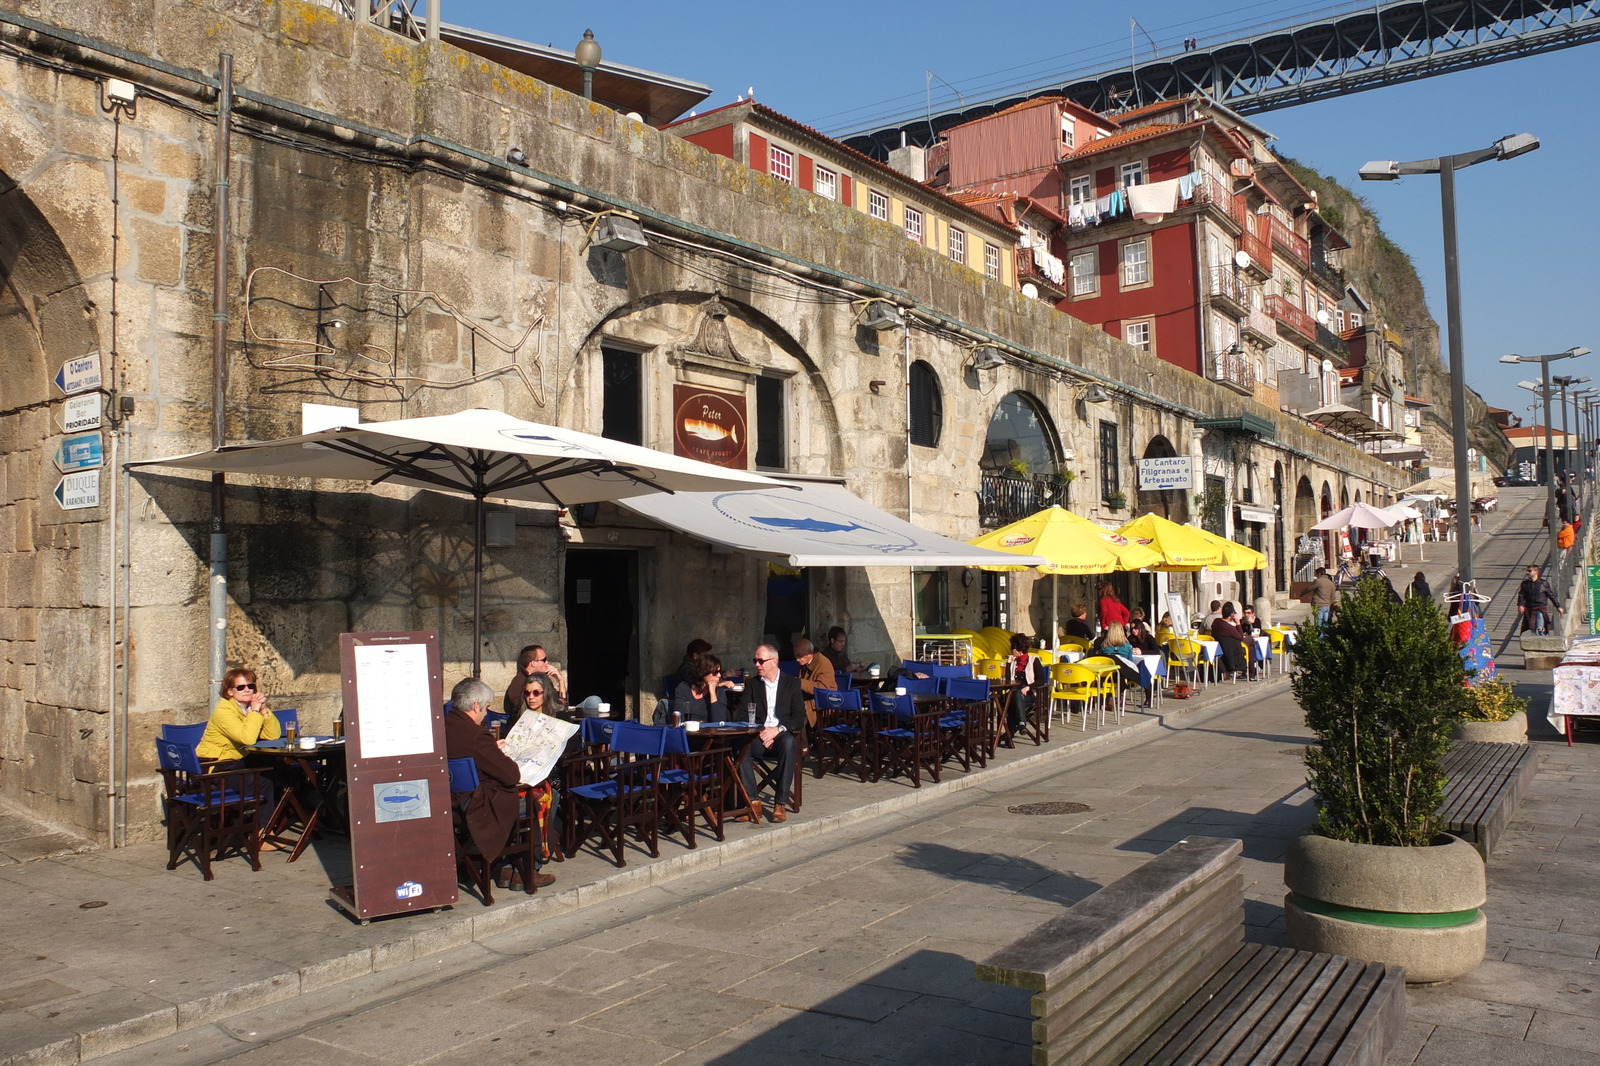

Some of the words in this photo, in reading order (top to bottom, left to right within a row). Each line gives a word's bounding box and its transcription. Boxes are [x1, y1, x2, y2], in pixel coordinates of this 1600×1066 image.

[76, 410, 87, 418] Bar
[702, 404, 721, 420] Peter
[66, 416, 99, 430] PRIORIDADE
[1144, 459, 1150, 467] O
[1154, 459, 1186, 467] Cantaro
[1141, 468, 1181, 477] Filigranas
[66, 475, 97, 493] DUQUE
[1144, 475, 1188, 484] Artesanato
[66, 496, 86, 506] KARAOKE
[87, 495, 96, 504] BAR
